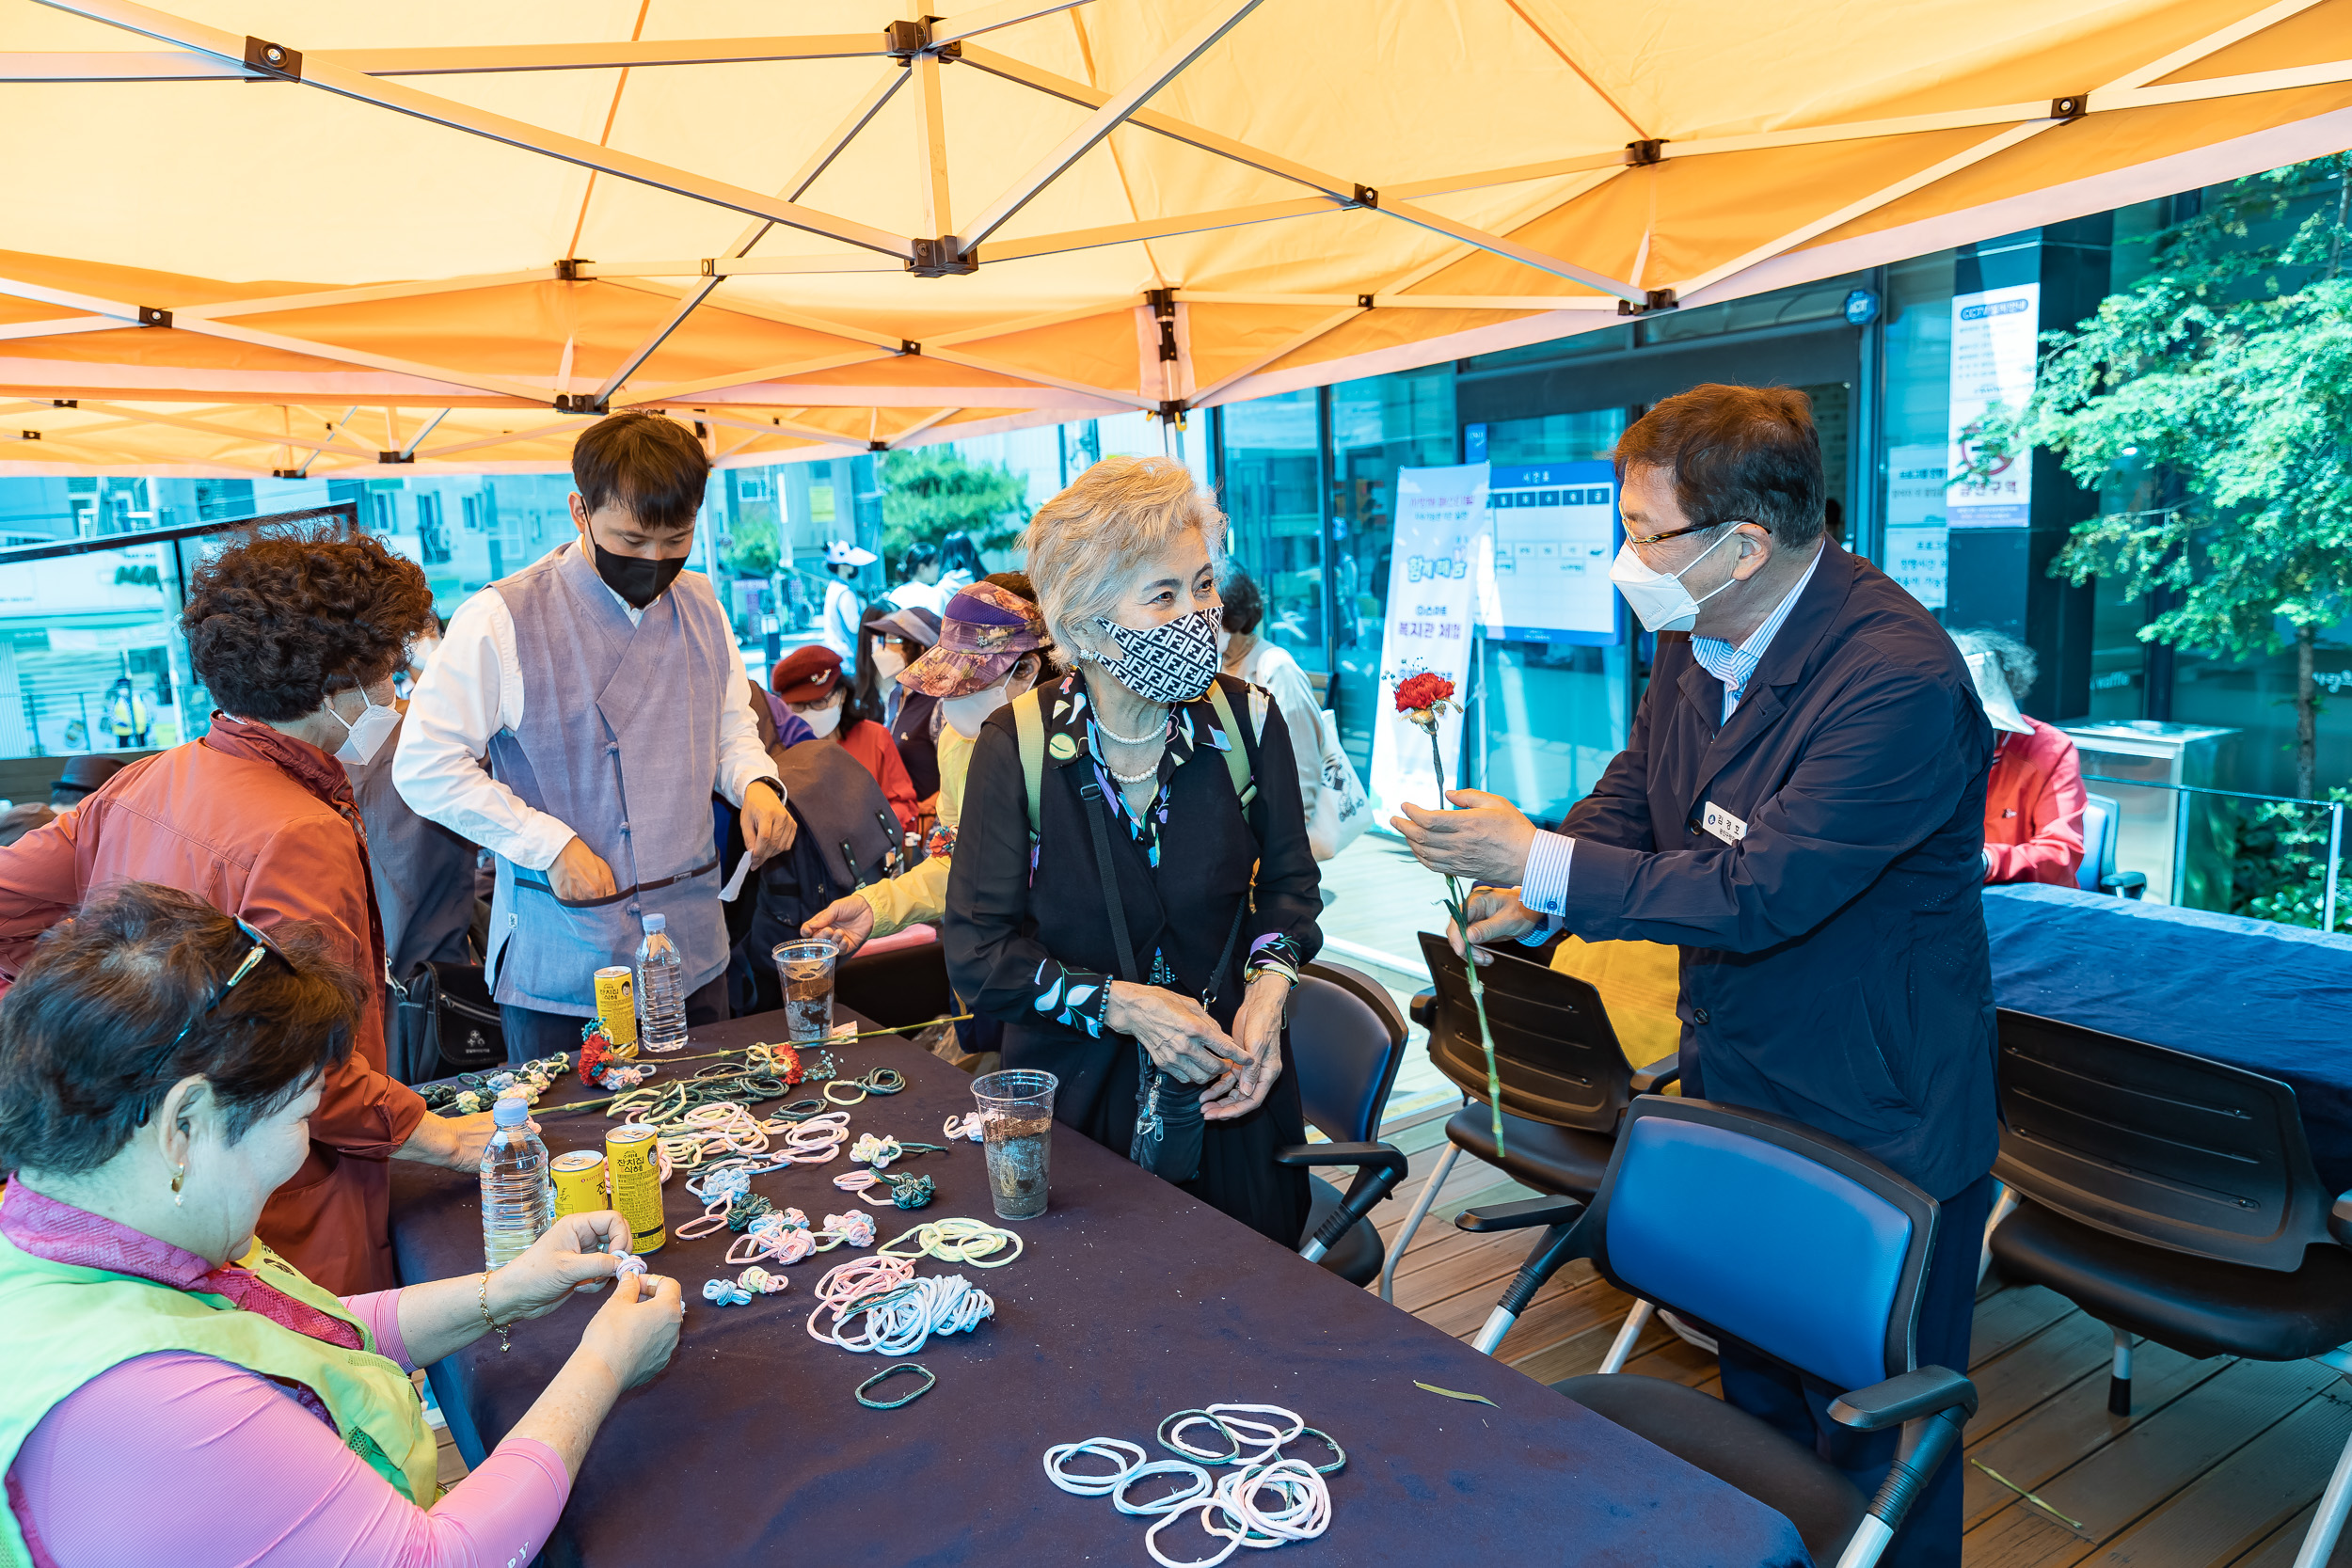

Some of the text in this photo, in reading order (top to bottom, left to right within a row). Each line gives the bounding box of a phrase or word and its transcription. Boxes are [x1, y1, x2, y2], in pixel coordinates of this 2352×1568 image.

[1399, 622, 1461, 640] 복지관 체험
[617, 1156, 644, 1167] 잔치집
[586, 1173, 601, 1182] LOTTE
